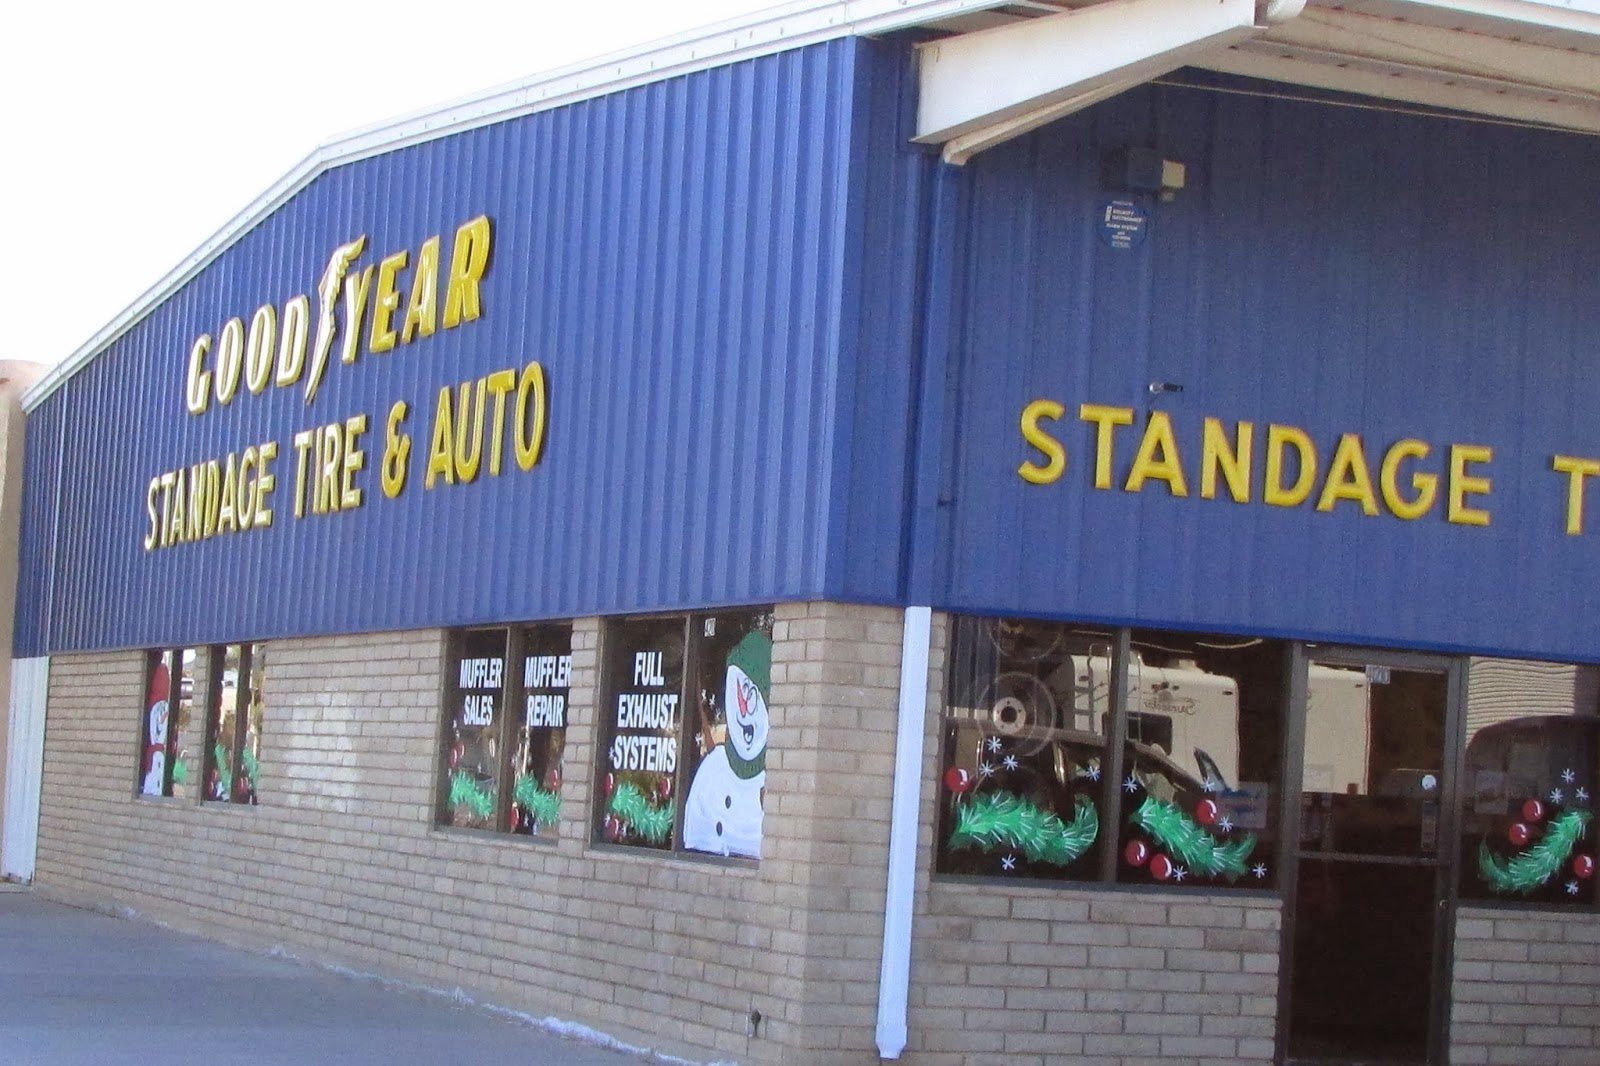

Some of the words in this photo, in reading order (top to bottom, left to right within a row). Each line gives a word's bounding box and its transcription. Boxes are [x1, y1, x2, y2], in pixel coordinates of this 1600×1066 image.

[186, 214, 490, 415] GOODYEAR
[144, 441, 278, 552] STANDAGE
[294, 413, 367, 518] TIRE
[381, 400, 410, 498] &
[425, 361, 546, 490] AUTO
[1017, 399, 1492, 526] STANDAGE
[1553, 455, 1600, 536] T
[459, 658, 503, 689] MUFFLER
[524, 655, 572, 688] MUFFLER
[634, 651, 665, 686] FULL
[463, 695, 494, 726] SALES
[526, 694, 565, 727] REPAIR
[617, 694, 678, 729] EXHAUST
[613, 736, 677, 774] SYSTEMS
